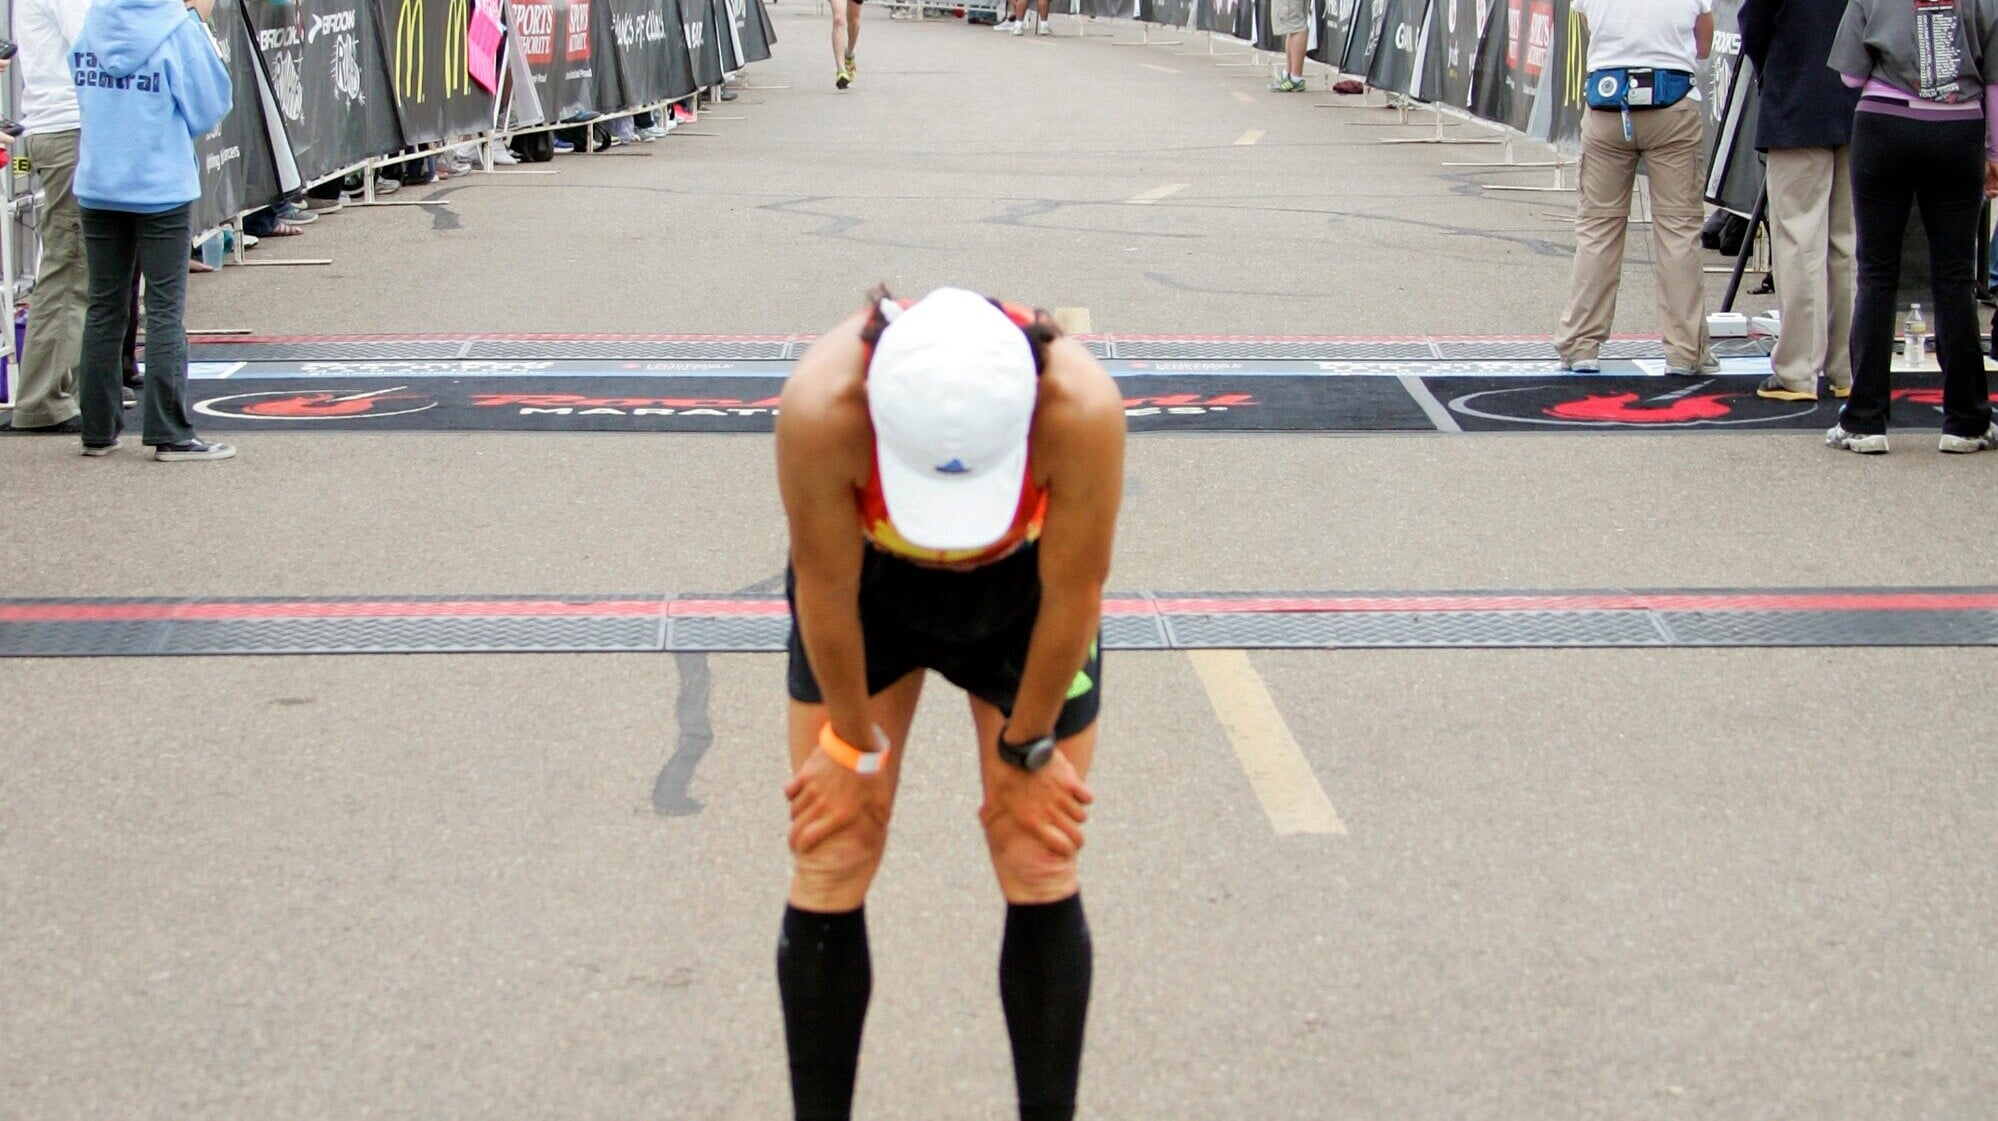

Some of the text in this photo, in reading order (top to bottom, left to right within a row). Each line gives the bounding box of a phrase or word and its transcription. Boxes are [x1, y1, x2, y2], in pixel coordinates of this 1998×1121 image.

[74, 52, 99, 68] ra
[74, 70, 161, 93] central
[519, 407, 781, 416] MARAT
